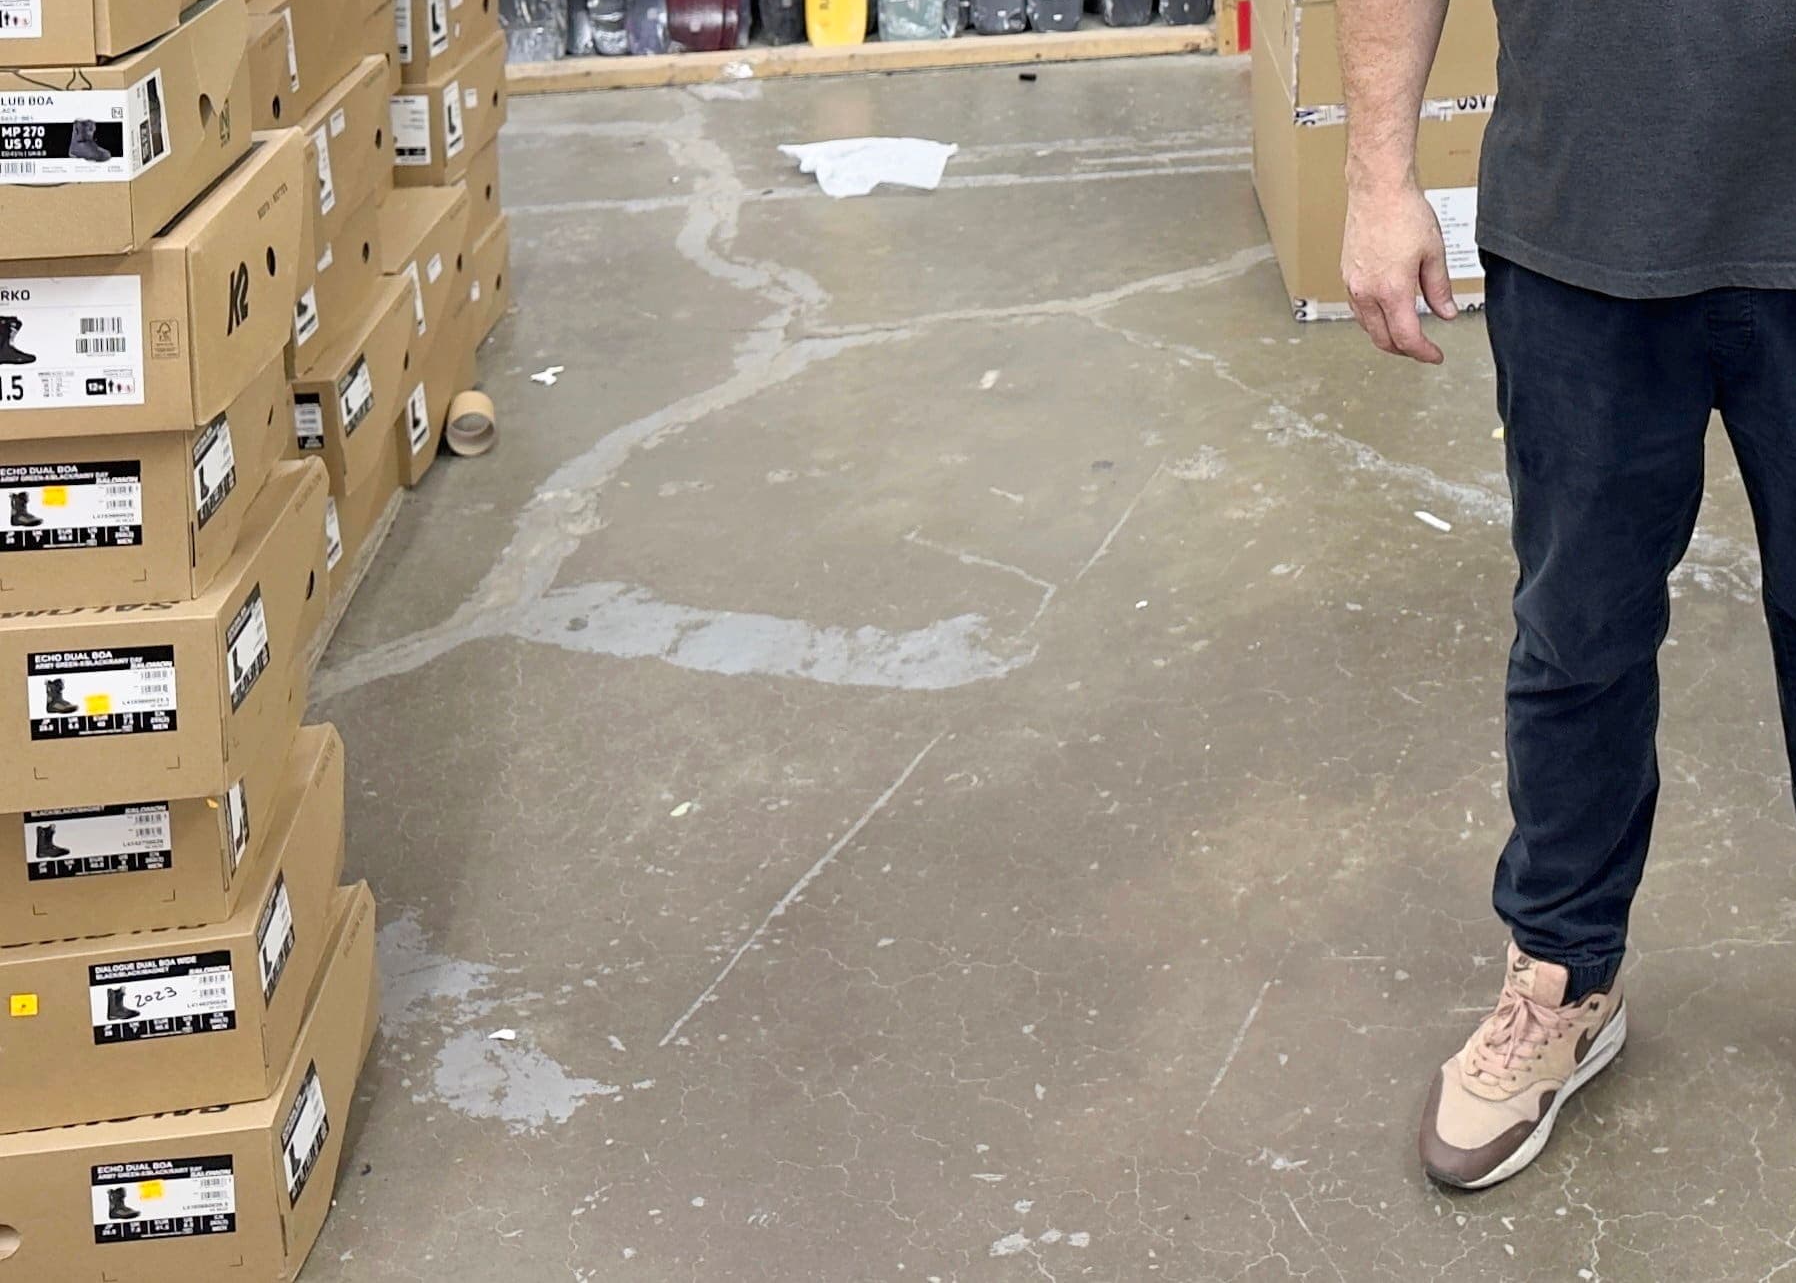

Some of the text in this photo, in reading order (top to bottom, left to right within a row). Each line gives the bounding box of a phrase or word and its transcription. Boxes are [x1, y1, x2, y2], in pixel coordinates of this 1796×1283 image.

[28, 96, 55, 105] BOA
[1, 126, 46, 138] MP 270
[4, 139, 43, 149] US 9.0
[227, 261, 249, 336] K2
[29, 467, 55, 475] DUAL
[57, 466, 79, 474] BOA
[35, 651, 112, 663] ECHO DUAL BOA
[136, 961, 158, 970] DUAL
[177, 956, 197, 964] WIDE
[135, 986, 177, 1008] 2023
[97, 1166, 123, 1174] ECHO
[126, 1164, 150, 1172] DUAL
